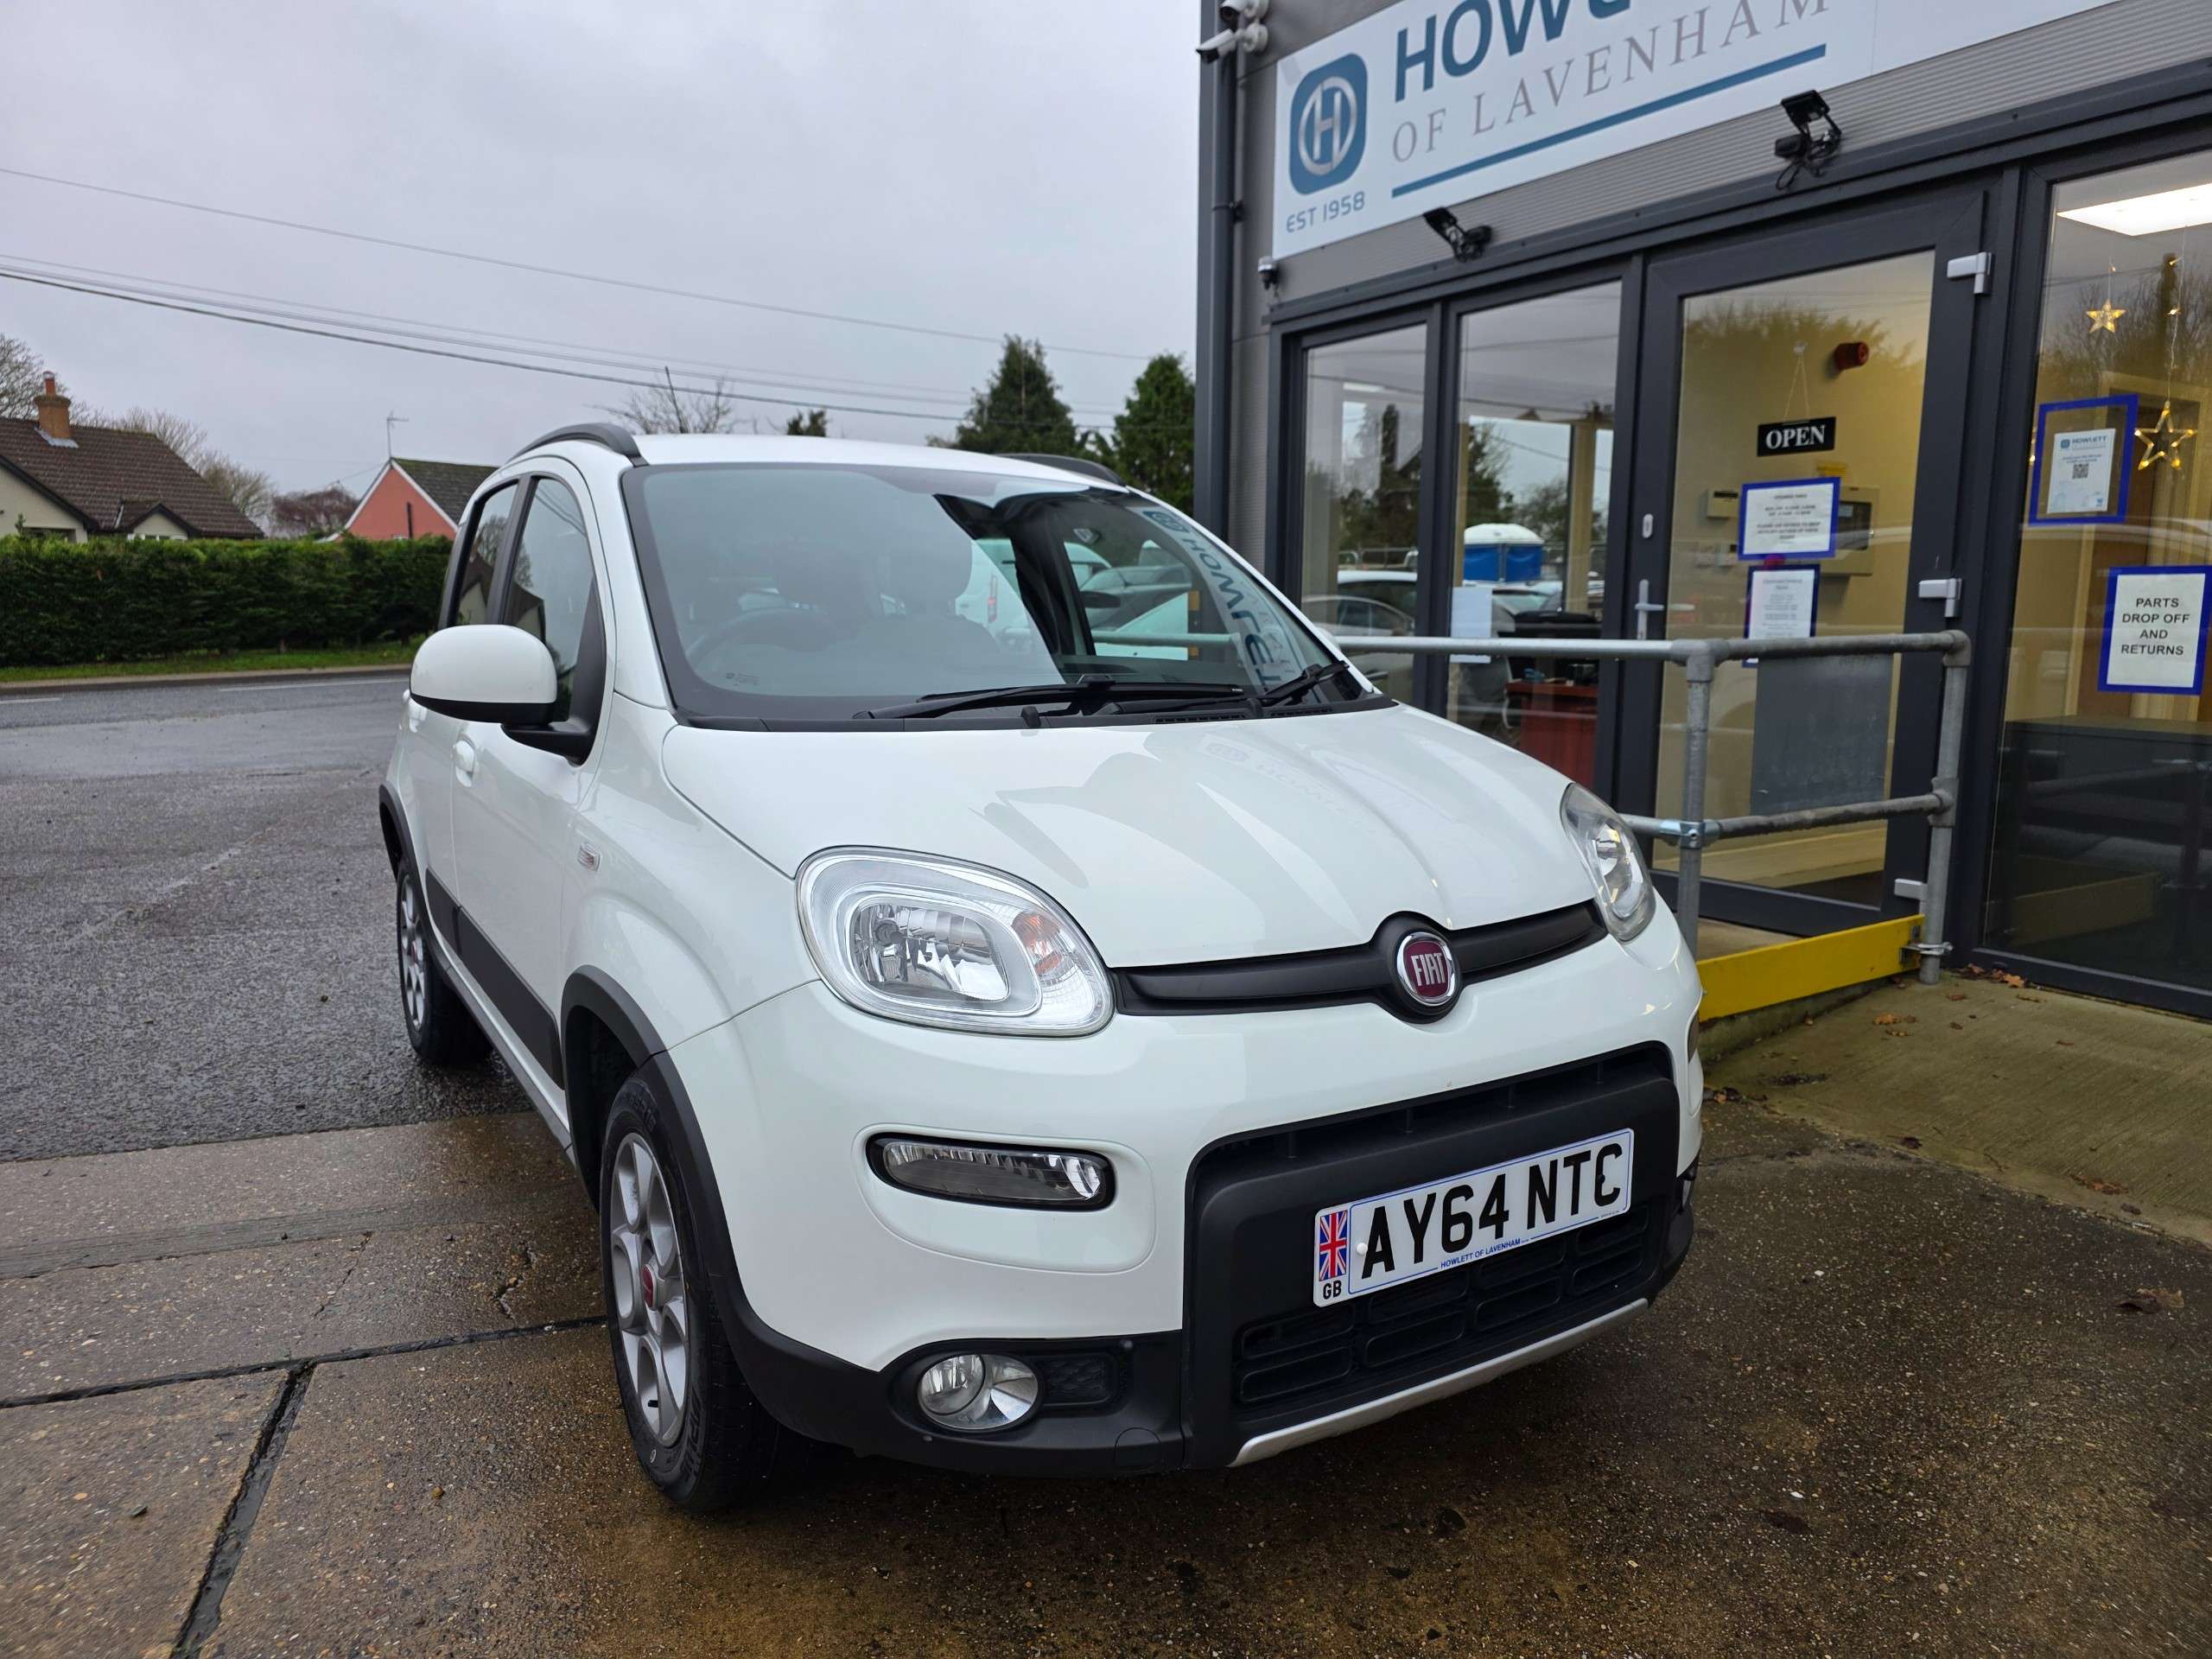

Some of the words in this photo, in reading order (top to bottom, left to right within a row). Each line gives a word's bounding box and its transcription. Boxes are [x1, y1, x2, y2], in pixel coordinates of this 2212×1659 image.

[1395, 0, 1630, 103] HOW
[1392, 107, 1447, 162] OF
[1285, 207, 1318, 233] EST
[1323, 190, 1366, 223] 1958
[1765, 424, 1826, 449] OPEN
[2135, 597, 2179, 608] PARTS
[2121, 613, 2160, 624] DROP
[2164, 613, 2190, 624] OFF
[2139, 629, 2169, 640] AND
[2120, 644, 2184, 656] RETURNS
[1410, 952, 1446, 987] FIAT
[1361, 1173, 1510, 1280] AY64
[1526, 1142, 1624, 1230] NTC
[1440, 1253, 1473, 1269] HOWLETT
[1474, 1249, 1485, 1259] OF
[1484, 1237, 1522, 1255] LAVENHAM
[1322, 1280, 1343, 1300] GB
